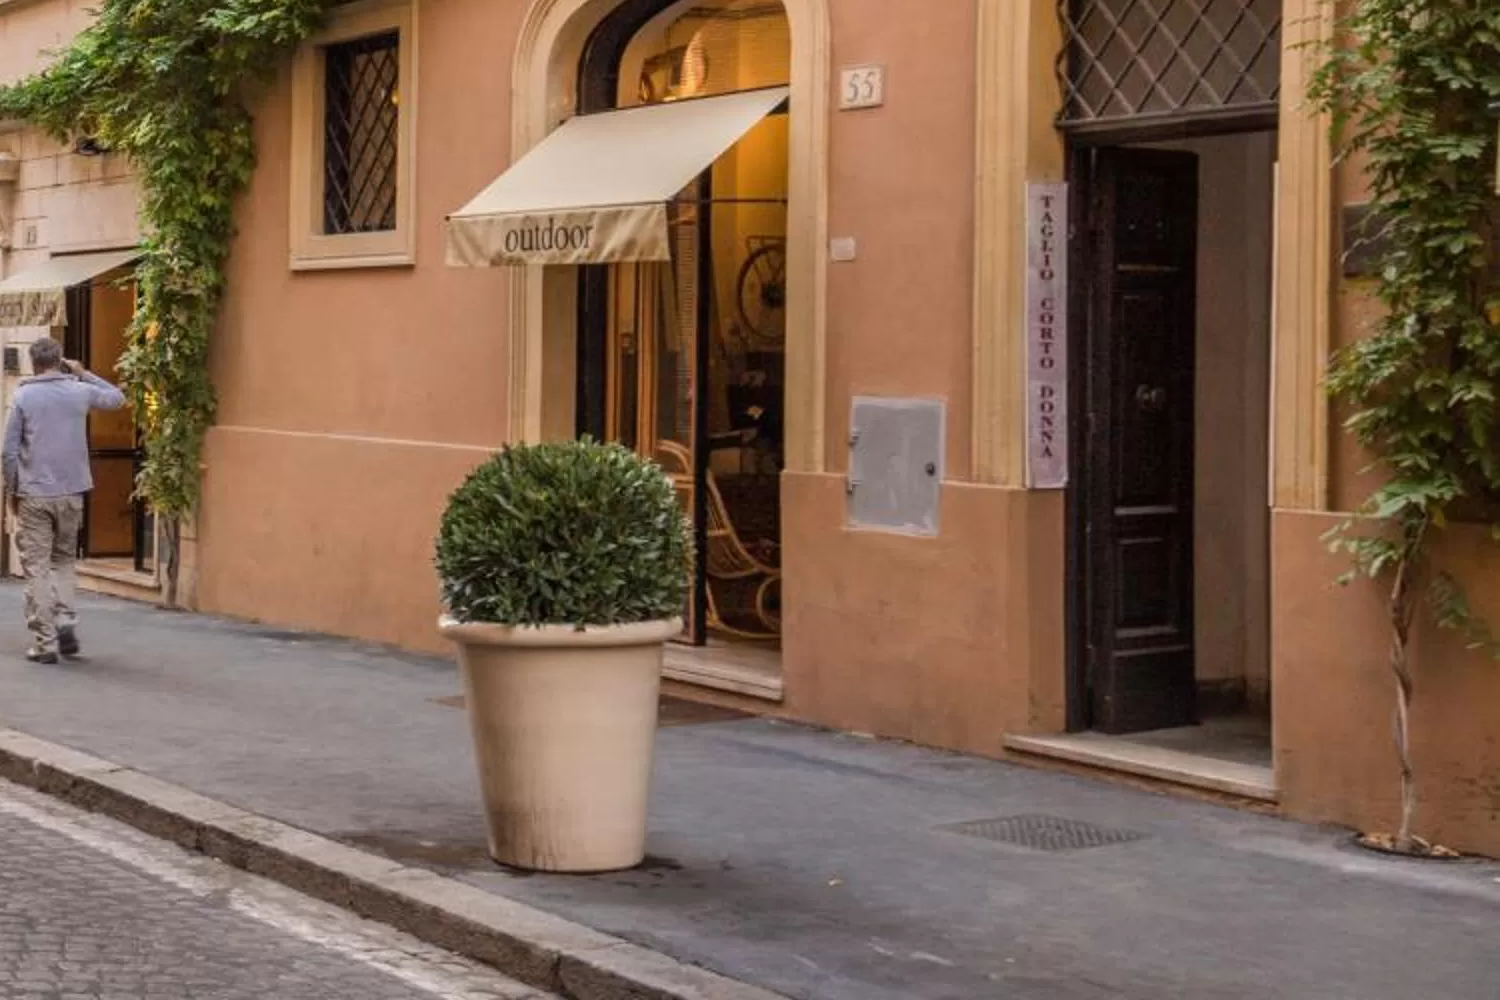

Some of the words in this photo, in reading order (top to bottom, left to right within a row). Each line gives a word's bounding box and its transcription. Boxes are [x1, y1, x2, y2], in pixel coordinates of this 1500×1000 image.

[846, 71, 876, 103] 55
[505, 217, 593, 252] outdoor
[1039, 195, 1055, 282] TAGLIO
[1039, 298, 1055, 370] CORTO
[1039, 385, 1055, 458] DONNA
